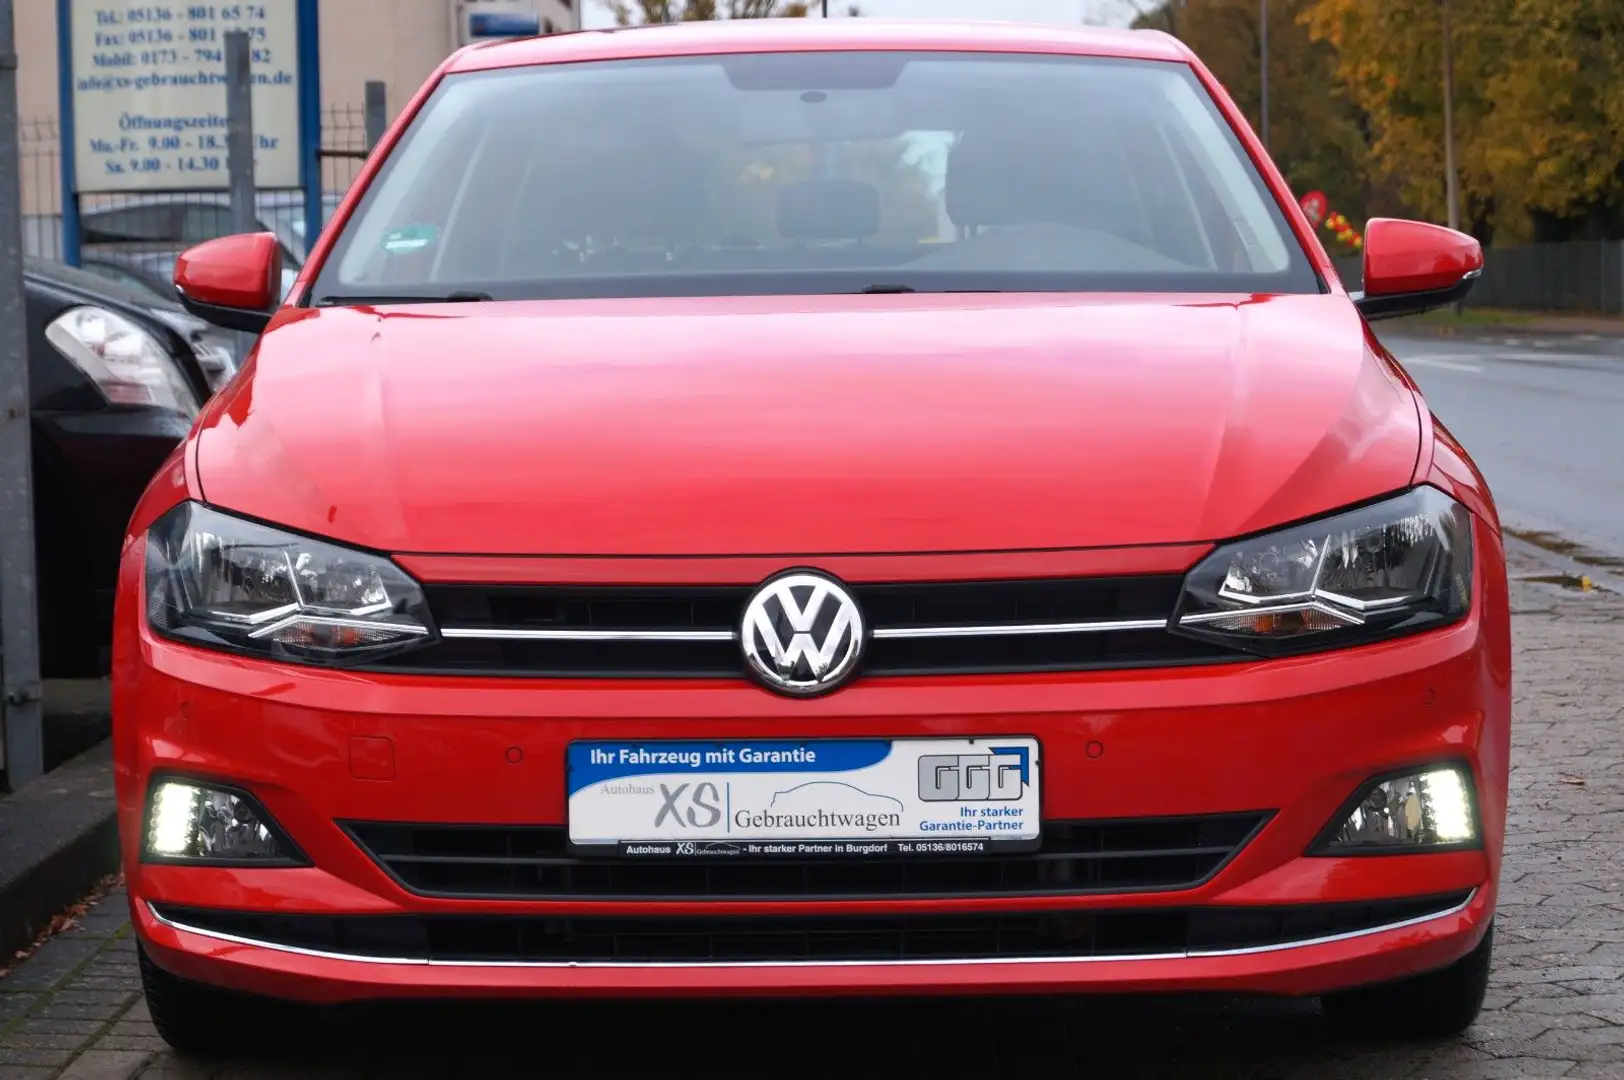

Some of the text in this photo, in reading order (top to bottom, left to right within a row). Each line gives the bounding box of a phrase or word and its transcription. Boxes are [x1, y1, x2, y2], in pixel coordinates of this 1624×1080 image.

[127, 8, 171, 22] 05136
[187, 7, 215, 21] 801
[246, 5, 265, 20] 74
[128, 29, 172, 44] 05136
[188, 28, 216, 42] 801
[141, 49, 177, 65] 0173
[194, 48, 222, 63] 794
[77, 69, 292, 92] info@xs-gebrauchtwen.de
[119, 112, 231, 132] Öffnungszeite
[148, 135, 180, 150] 9.00
[130, 157, 160, 173] 9.00
[177, 155, 220, 172] 14.30
[744, 574, 861, 686] VW
[590, 747, 816, 768] Ihr Fahrzeug mit Garantie
[600, 781, 901, 833] Autohaus XS Gebrauchtwagen
[959, 805, 1024, 818] Ihr starker
[919, 819, 1024, 832] Garantie-Partner
[626, 844, 672, 854] Autohaus
[675, 841, 694, 855] XS
[748, 844, 762, 853] Ihr
[763, 844, 796, 853] starker
[798, 844, 832, 853] Partner
[834, 844, 844, 853] in
[846, 843, 888, 855] Burgdorf
[898, 843, 914, 852] Tel.
[915, 842, 984, 852] 05136/8016574
